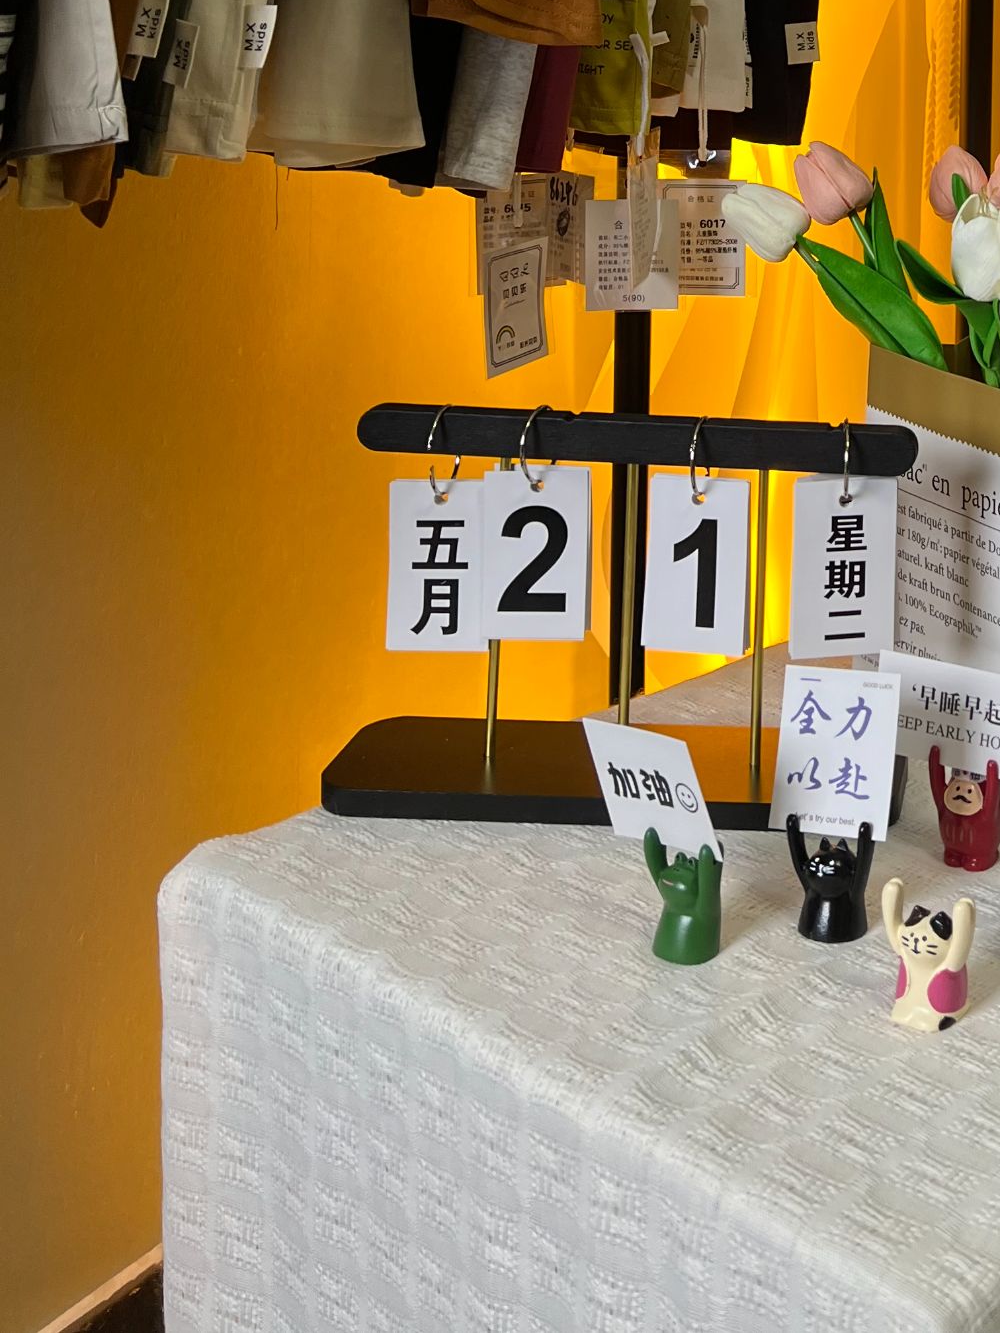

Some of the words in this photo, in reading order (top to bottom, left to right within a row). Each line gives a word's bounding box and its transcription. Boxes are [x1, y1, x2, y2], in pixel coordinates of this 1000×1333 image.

[135, 7, 153, 37] M.X
[147, 8, 163, 39] kids
[244, 22, 257, 51] M.X
[254, 22, 268, 52] kids
[796, 32, 806, 52] M.X
[807, 30, 816, 51] kids
[687, 195, 715, 204] 合格证
[699, 219, 726, 229] 6017
[622, 294, 646, 303] 5(90)
[931, 475, 951, 497] en
[908, 505, 942, 531] fabriqué
[943, 520, 949, 534] à
[950, 525, 975, 544] partir
[975, 535, 986, 550] de
[497, 505, 568, 613] 2
[672, 518, 718, 629] 1
[924, 557, 944, 576] kraft
[946, 566, 969, 588] blanc
[411, 518, 468, 635] 五月
[824, 513, 867, 642] 星期二
[897, 569, 908, 583] de
[909, 571, 928, 592] kraft
[930, 582, 951, 602] brun
[904, 593, 927, 613] 100%
[910, 620, 926, 636] pas.
[790, 689, 873, 741] 全力
[926, 720, 976, 744] EARLY
[607, 761, 674, 808] 加油
[787, 756, 870, 800] 以赴
[815, 813, 824, 824] try
[825, 816, 838, 824] our
[839, 817, 856, 827] best.
